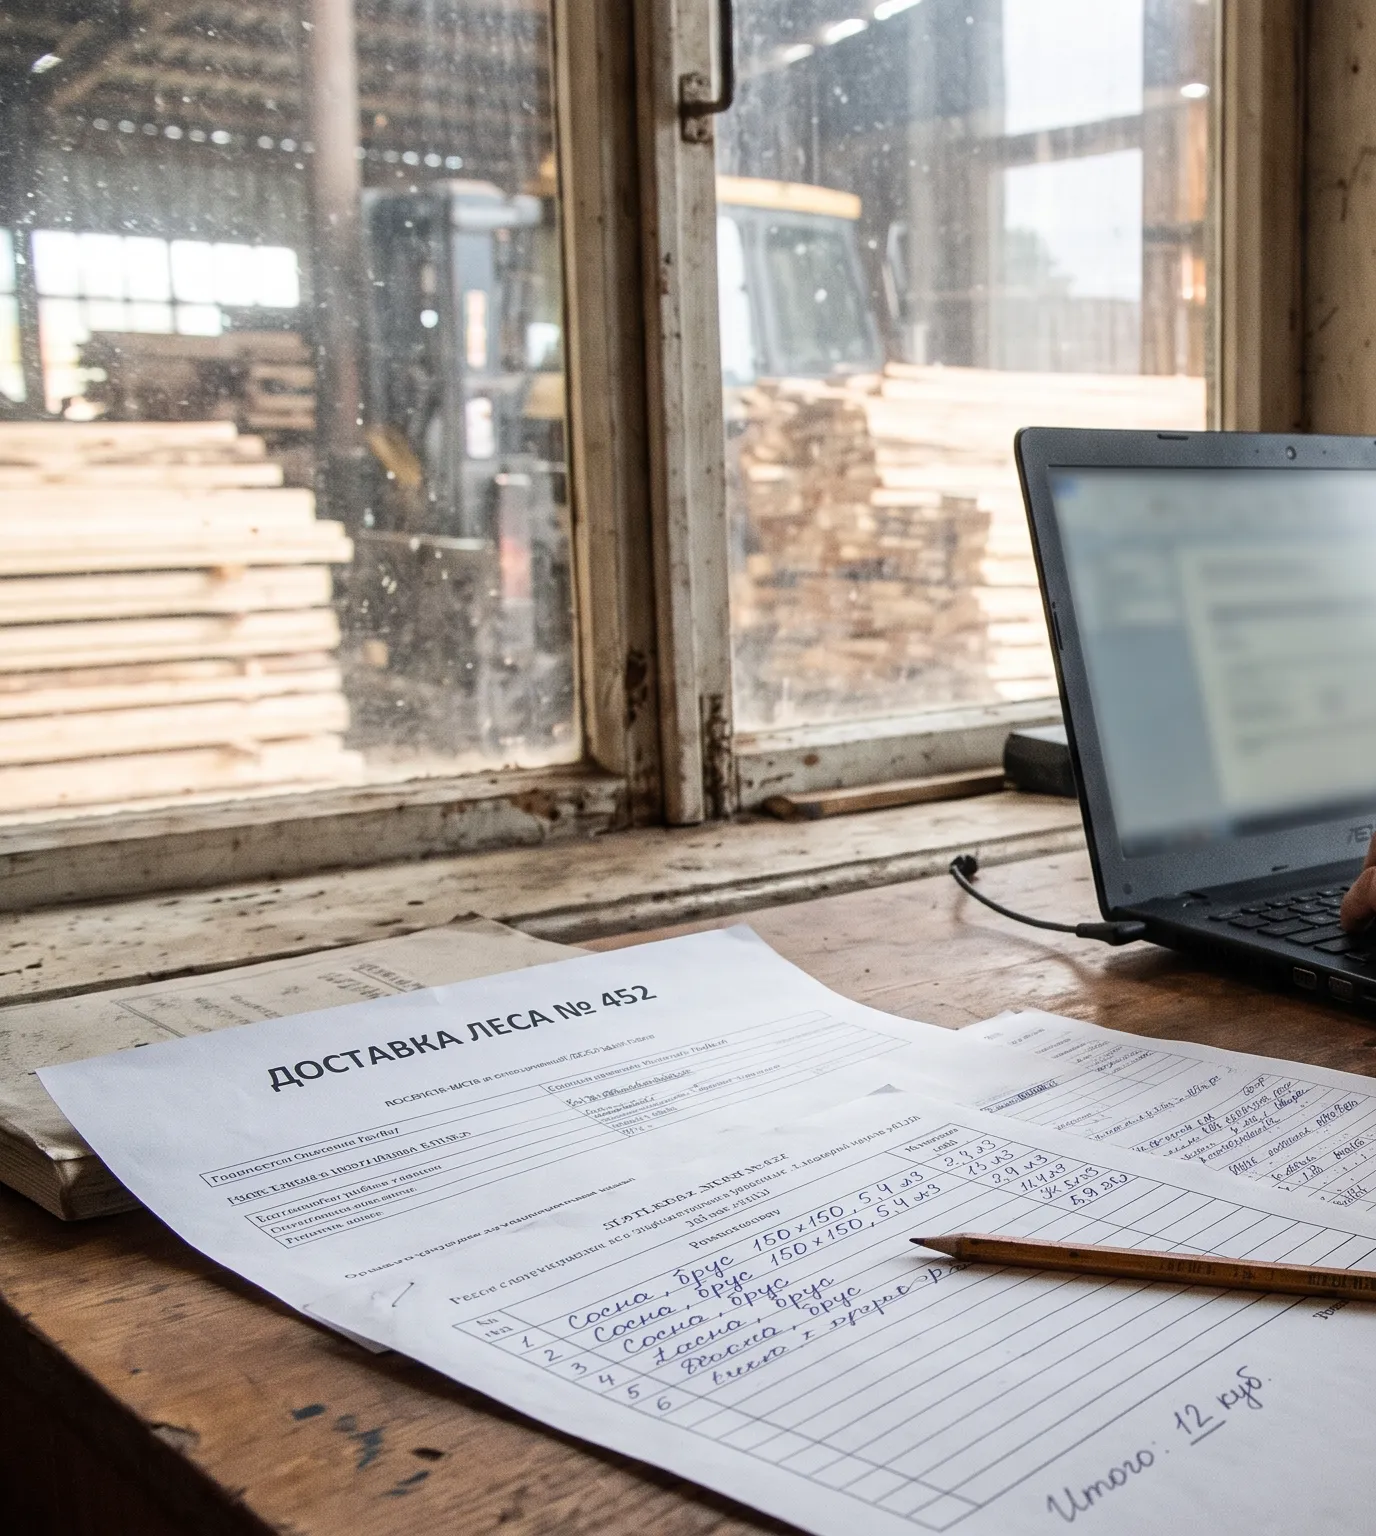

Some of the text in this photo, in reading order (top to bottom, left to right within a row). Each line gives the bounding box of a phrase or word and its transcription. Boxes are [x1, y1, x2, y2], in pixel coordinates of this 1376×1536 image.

[266, 984, 658, 1093] ДОСТАВКА ЛЕСА № 452
[521, 1336, 535, 1349] 1
[672, 1255, 734, 1289] брус
[543, 1349, 563, 1362] 2
[694, 1270, 754, 1299] брус
[570, 1362, 588, 1375] 3
[598, 1374, 616, 1387] 4
[628, 1383, 641, 1400] 5
[657, 1396, 672, 1411] 6
[1046, 1365, 1273, 1523] Итого: 12 куб.
